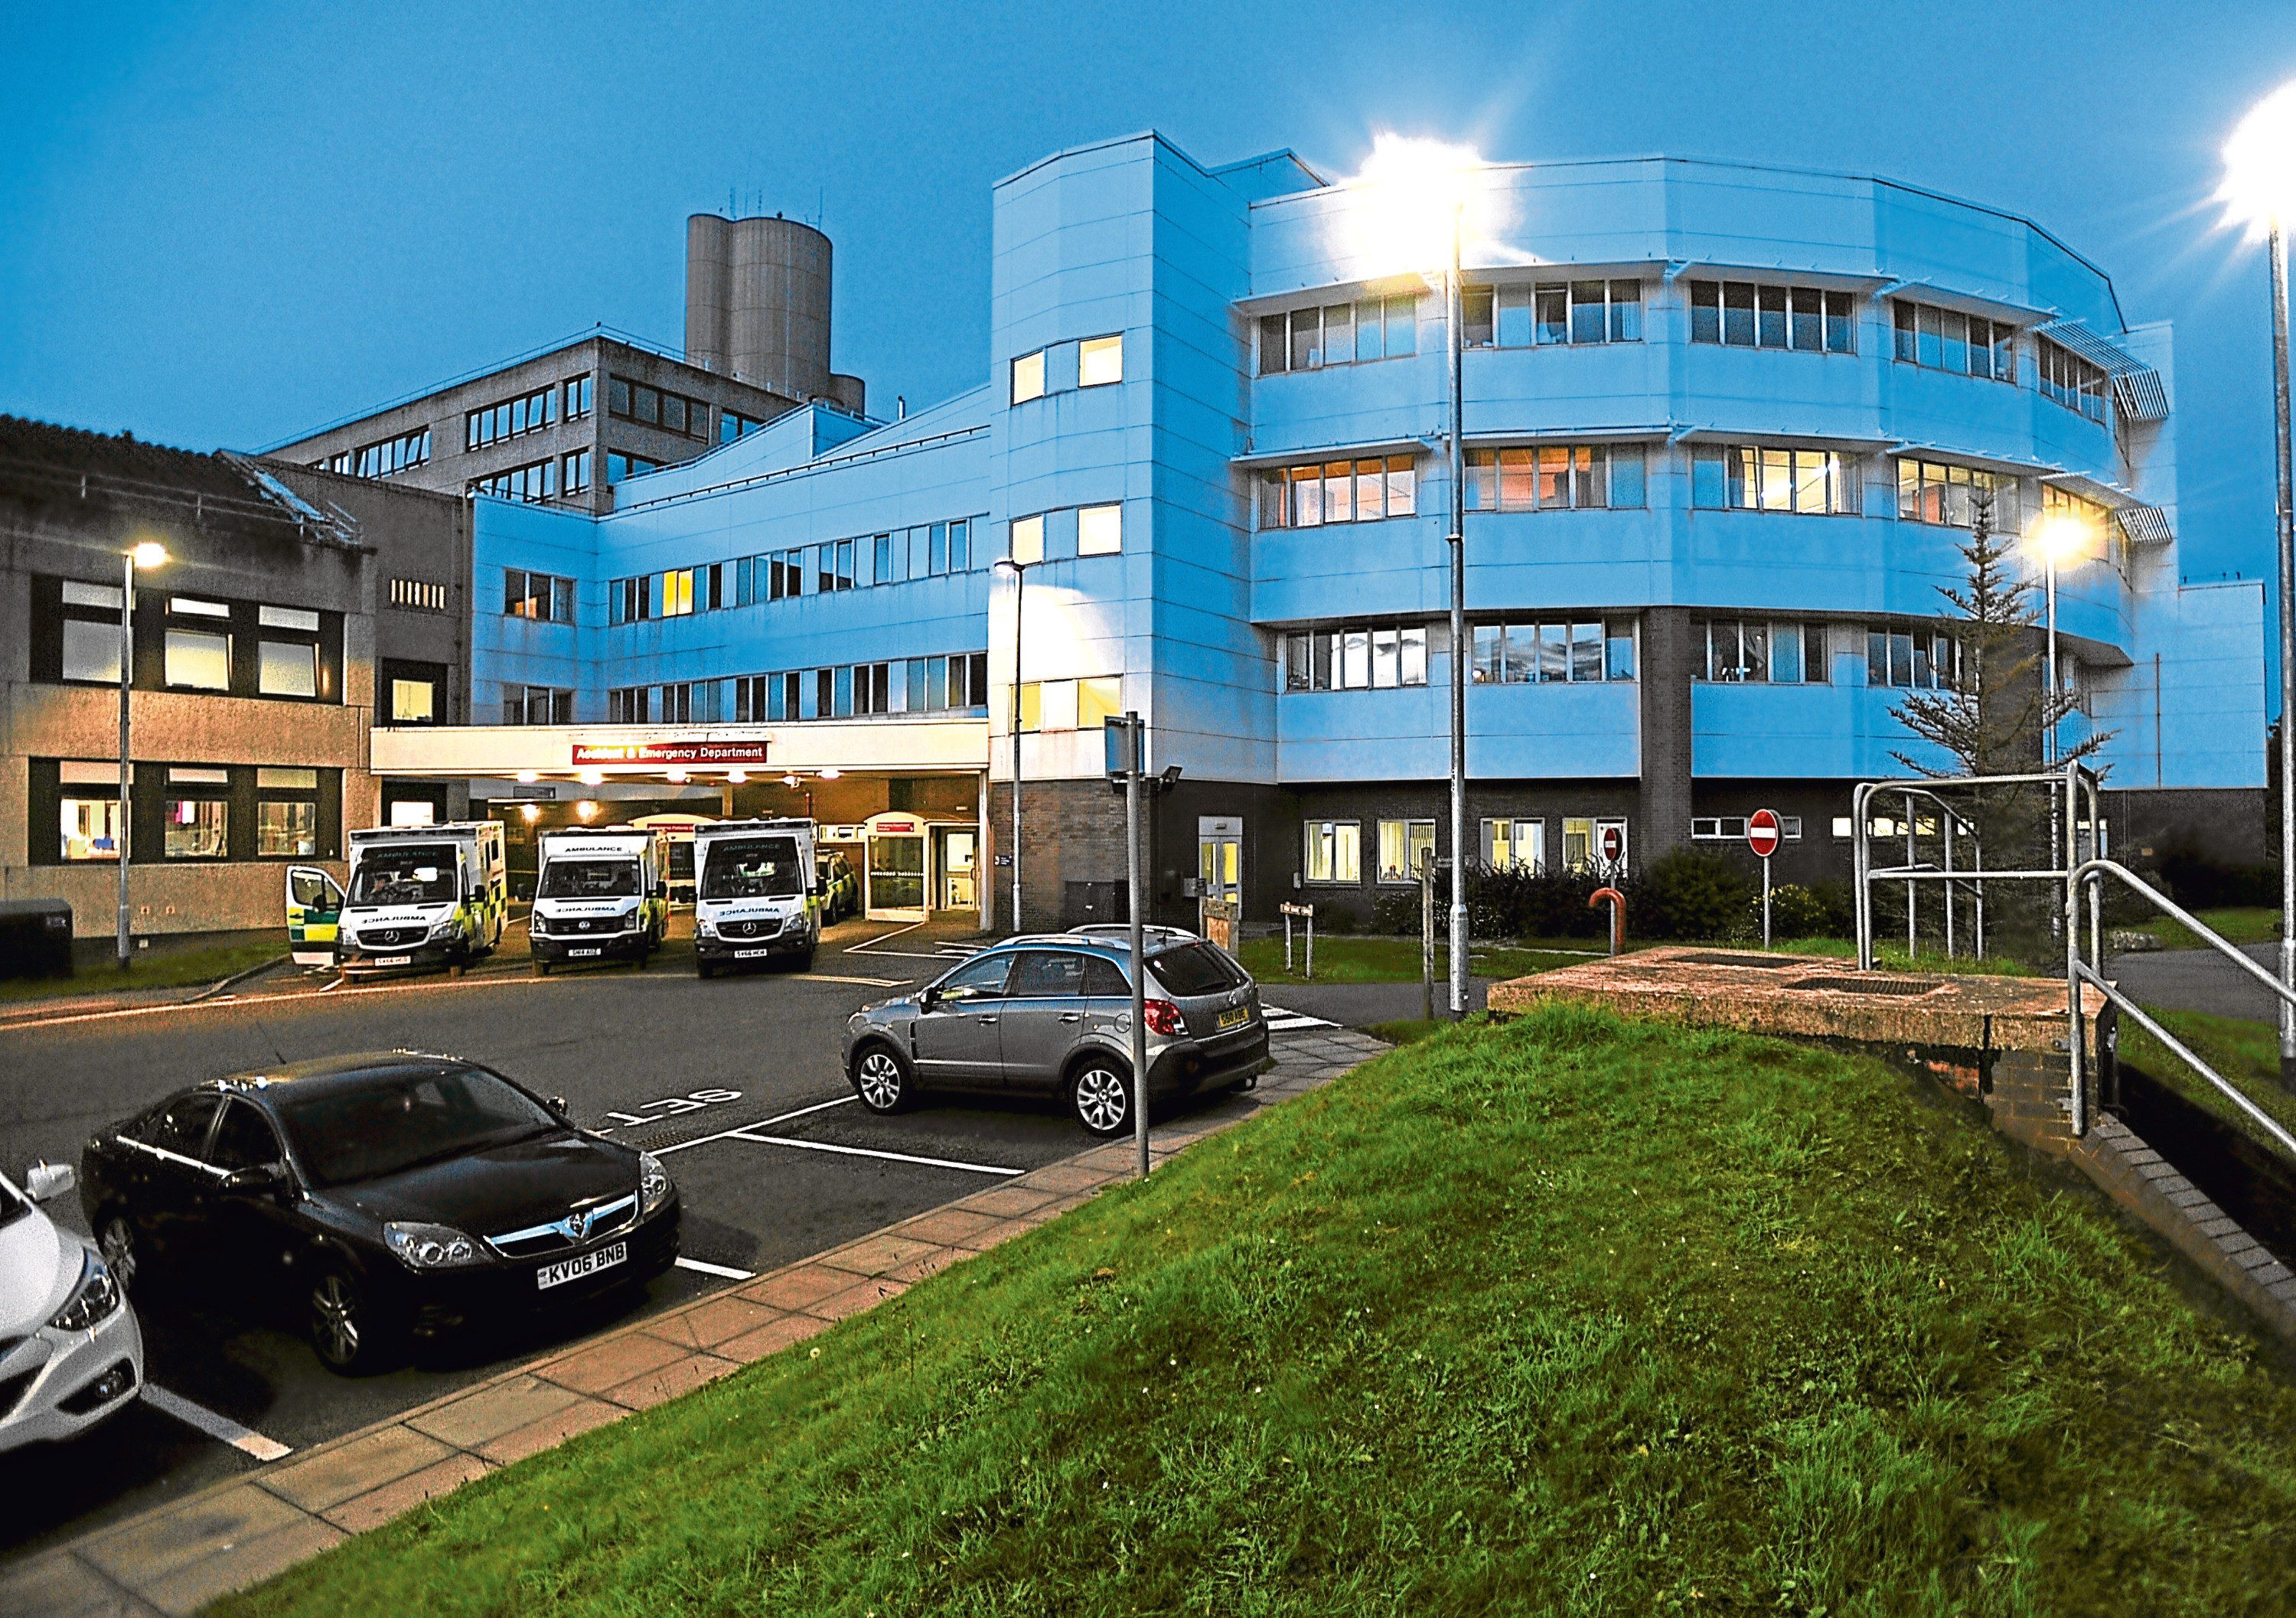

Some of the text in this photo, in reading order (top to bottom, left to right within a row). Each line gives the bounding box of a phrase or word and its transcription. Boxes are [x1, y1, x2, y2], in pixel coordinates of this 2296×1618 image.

[638, 747, 697, 759] Emergency
[700, 747, 763, 758] Department
[549, 1255, 592, 1284] KV06
[595, 1243, 625, 1267] BNB
